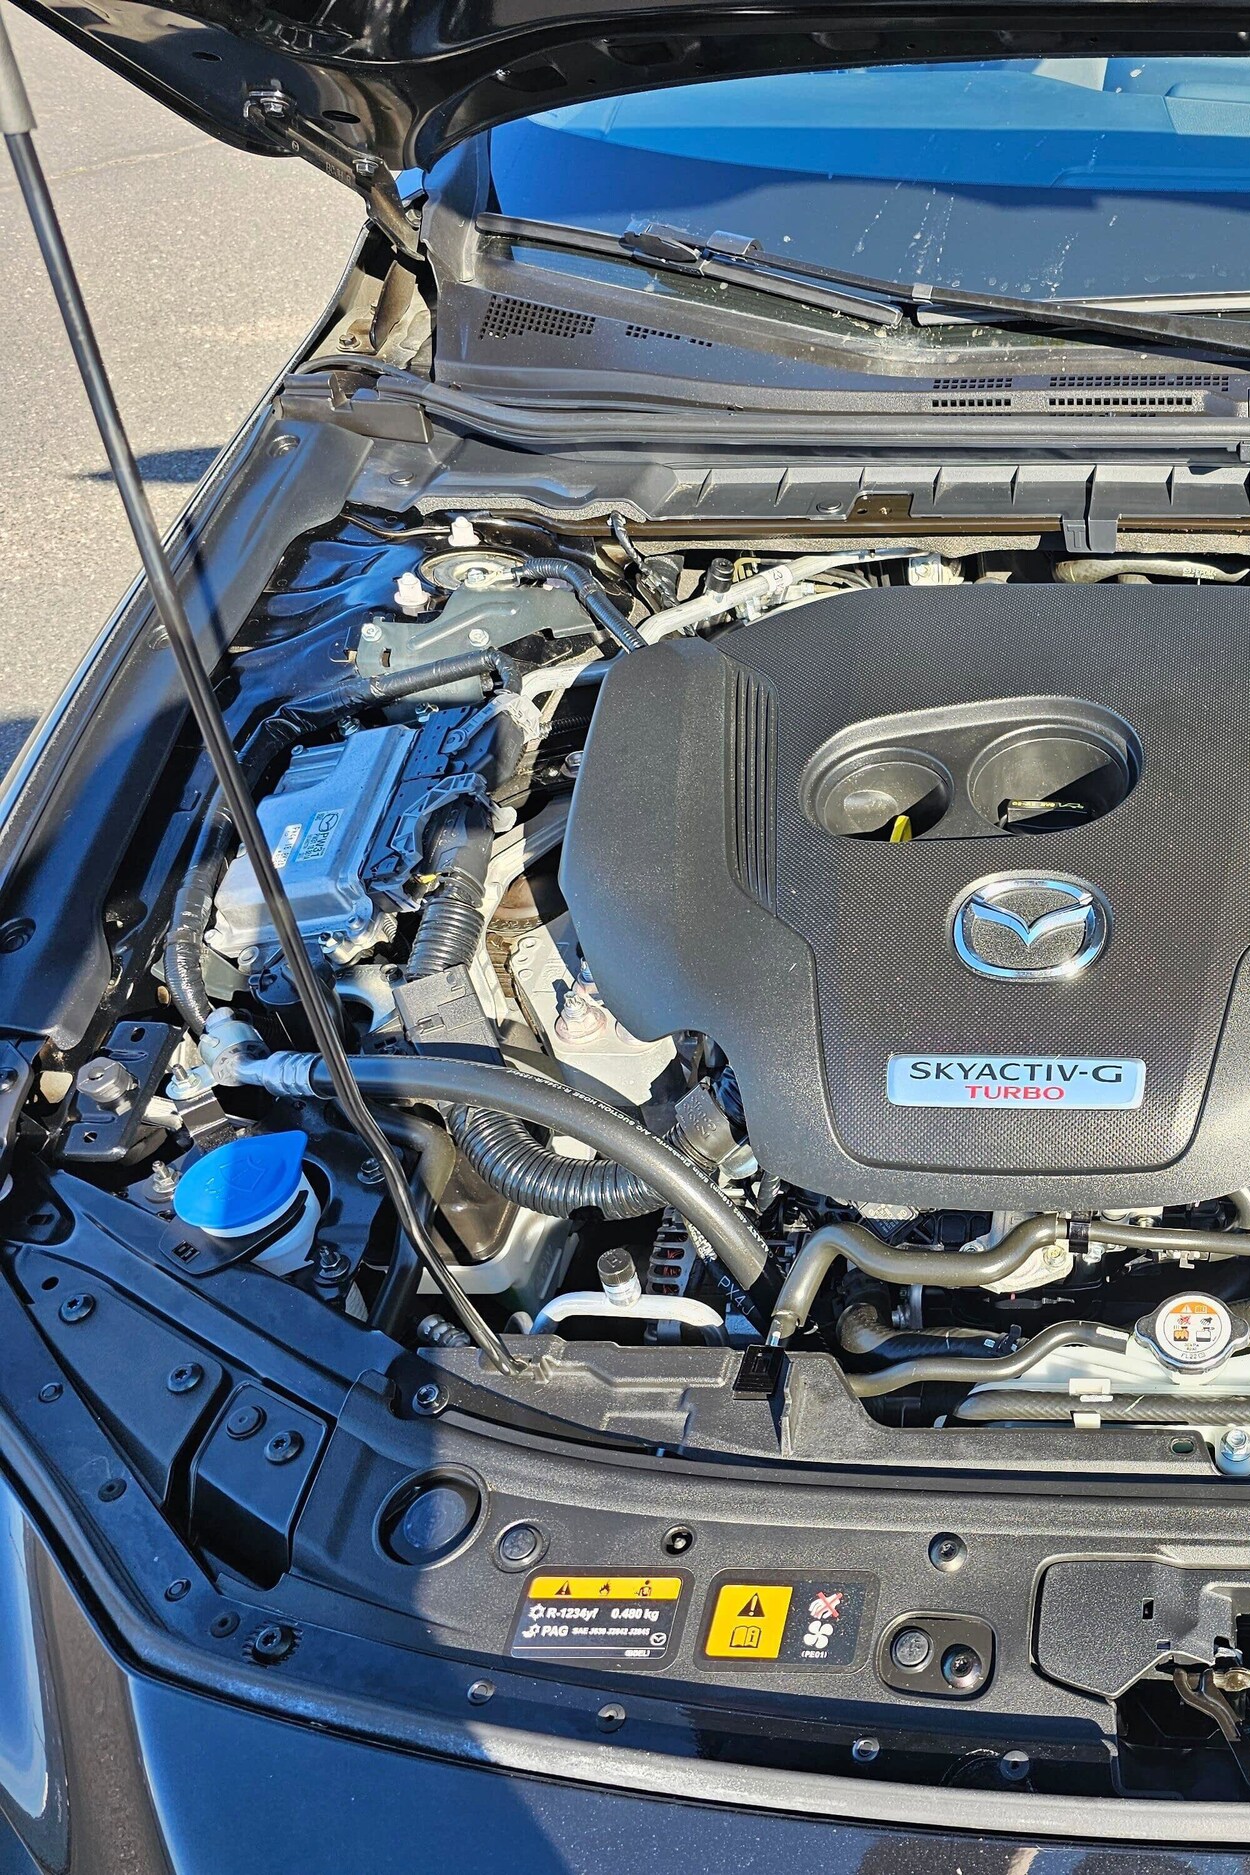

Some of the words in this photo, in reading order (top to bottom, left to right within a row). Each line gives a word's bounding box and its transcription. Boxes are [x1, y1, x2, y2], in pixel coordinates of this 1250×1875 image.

[909, 1061, 1123, 1083] SKYACTIV-G
[572, 1091, 598, 1105] HOSE
[965, 1085, 1065, 1100] TURBO
[598, 1103, 636, 1126] SUCTION
[717, 1276, 756, 1316] PX4J
[546, 1608, 599, 1621] R-1234yf
[643, 1608, 660, 1622] kg
[541, 1625, 569, 1636] PAG
